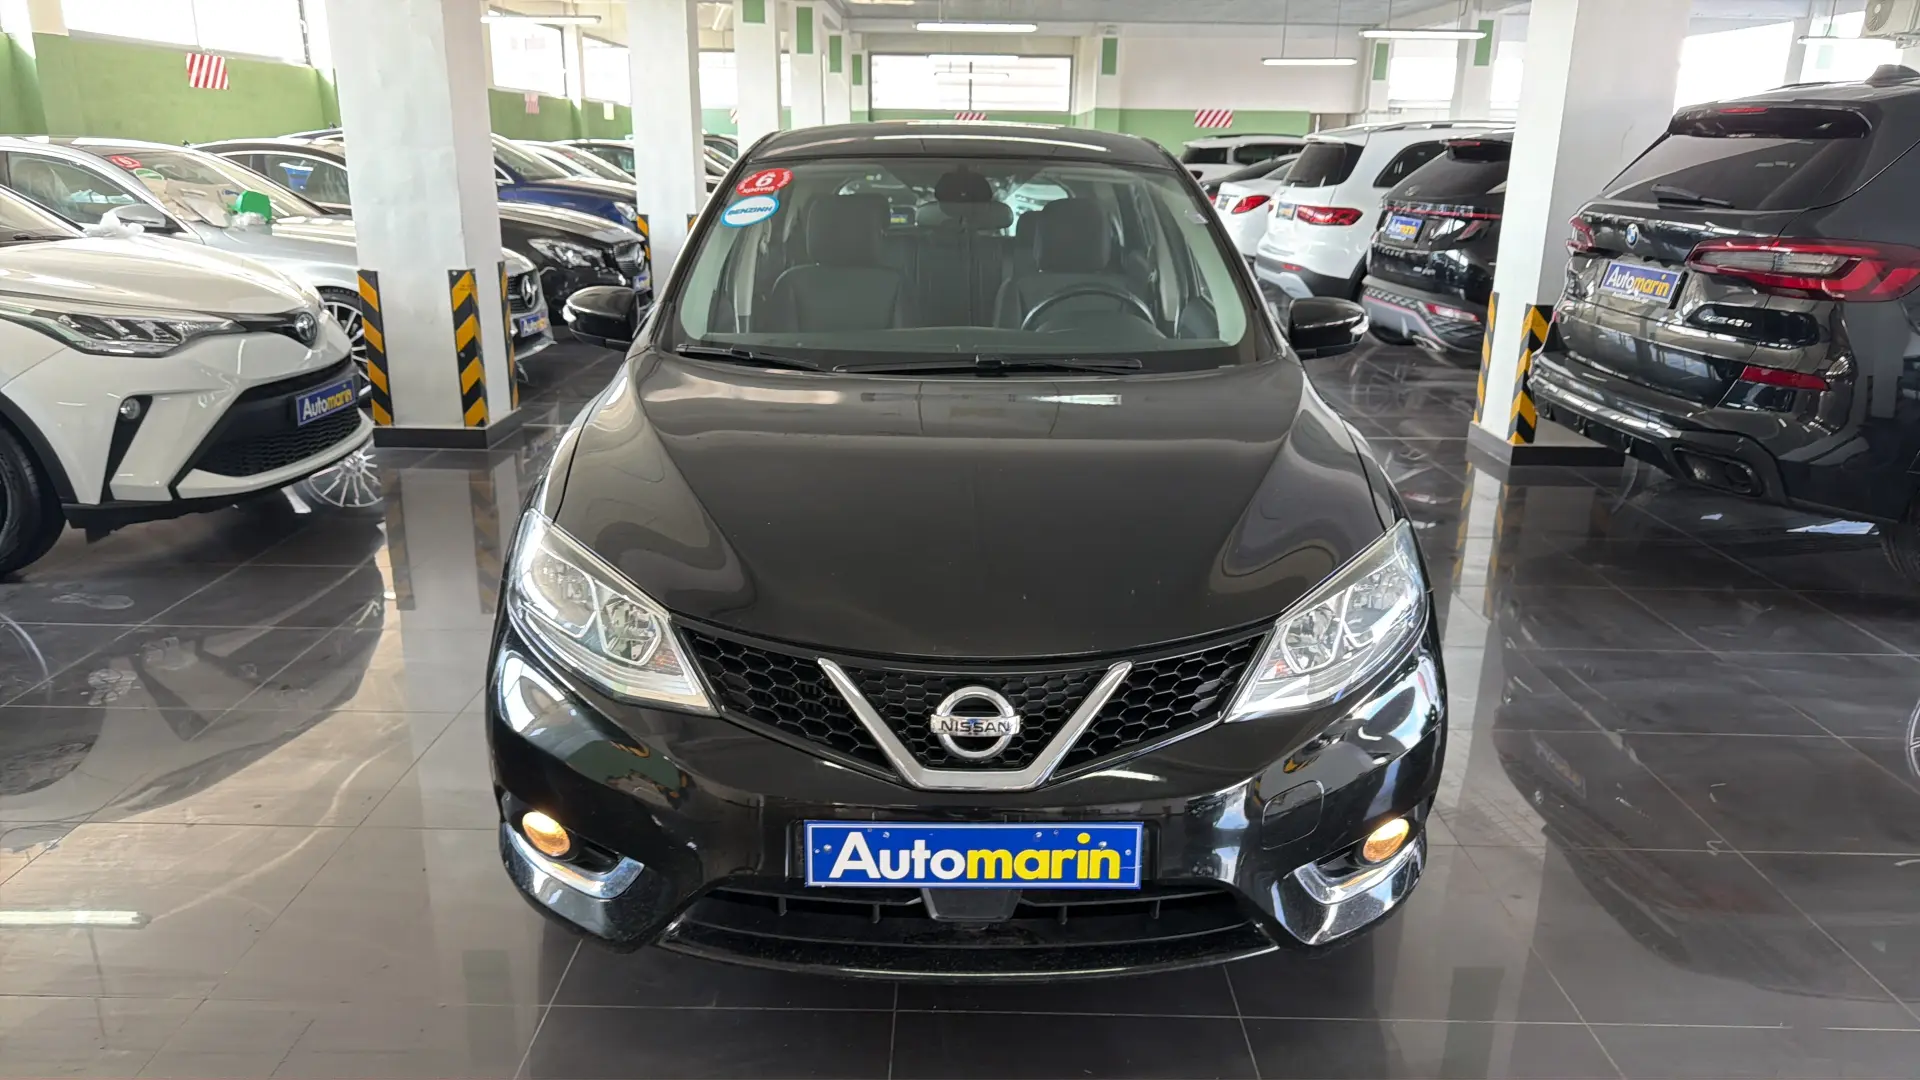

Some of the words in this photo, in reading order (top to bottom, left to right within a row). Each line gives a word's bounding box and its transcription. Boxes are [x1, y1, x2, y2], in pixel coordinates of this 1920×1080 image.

[755, 172, 776, 187] 6
[1606, 266, 1670, 297] Automarin
[303, 383, 352, 420] Automarin
[941, 720, 1010, 733] NISSAN
[829, 832, 1121, 880] Automarin
